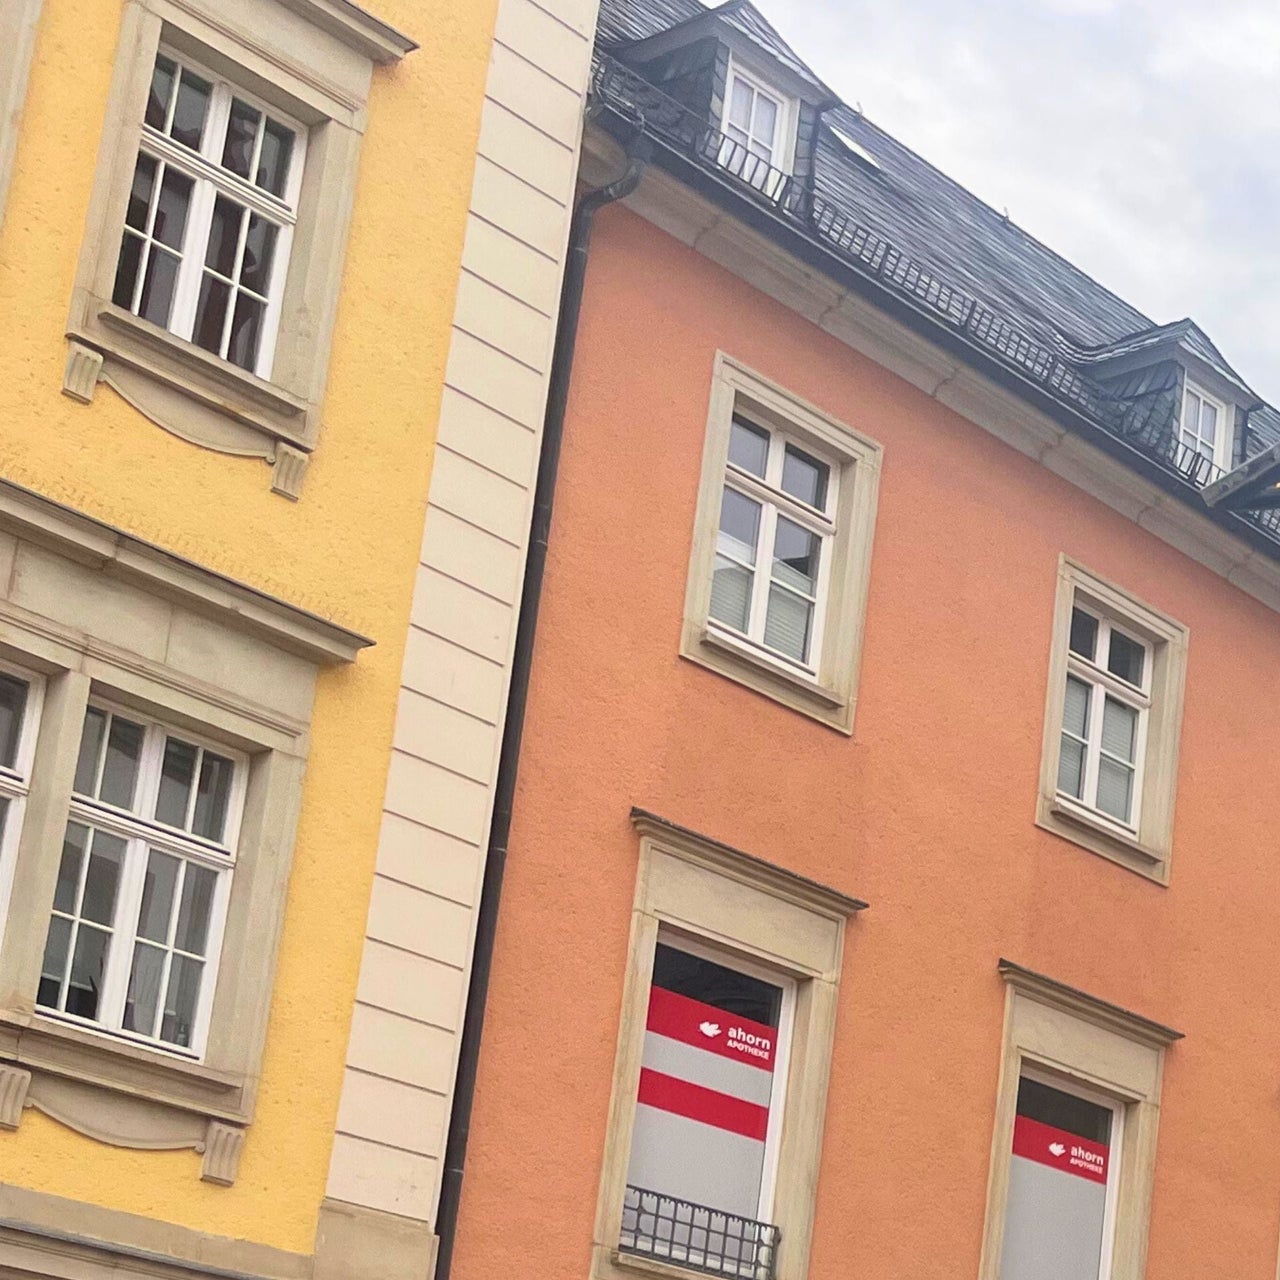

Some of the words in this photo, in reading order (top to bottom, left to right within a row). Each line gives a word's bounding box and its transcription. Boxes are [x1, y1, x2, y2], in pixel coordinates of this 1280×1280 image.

[728, 1027, 770, 1050] ahorn
[727, 1039, 769, 1060] APOTHEKE
[1071, 1146, 1104, 1166] ahorn
